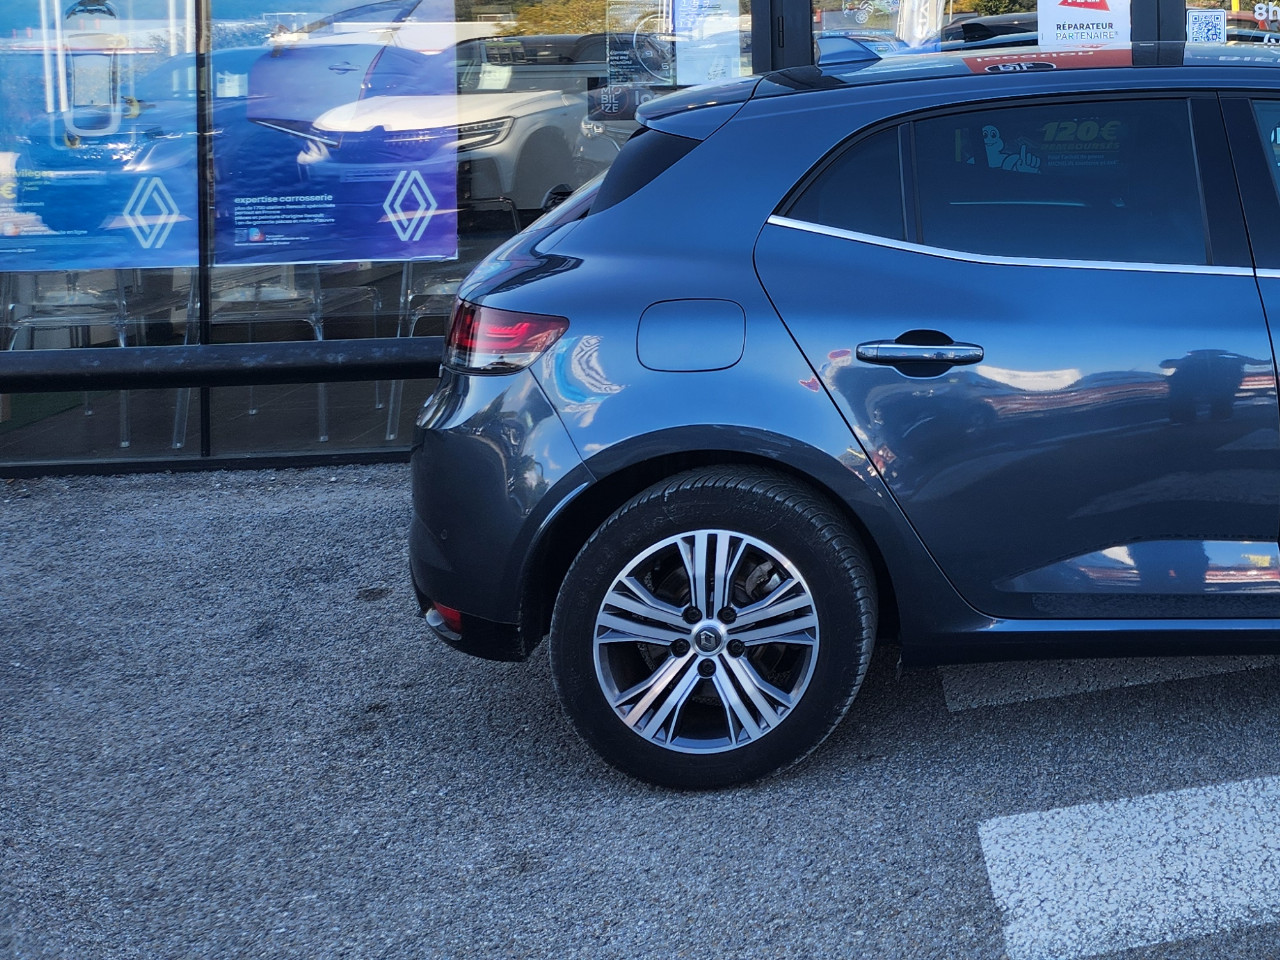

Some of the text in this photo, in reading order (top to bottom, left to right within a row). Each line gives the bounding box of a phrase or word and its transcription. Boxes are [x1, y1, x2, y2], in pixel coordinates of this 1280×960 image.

[1055, 21, 1114, 31] RÉPARATEUR
[234, 193, 334, 205] expertise carrosserie
